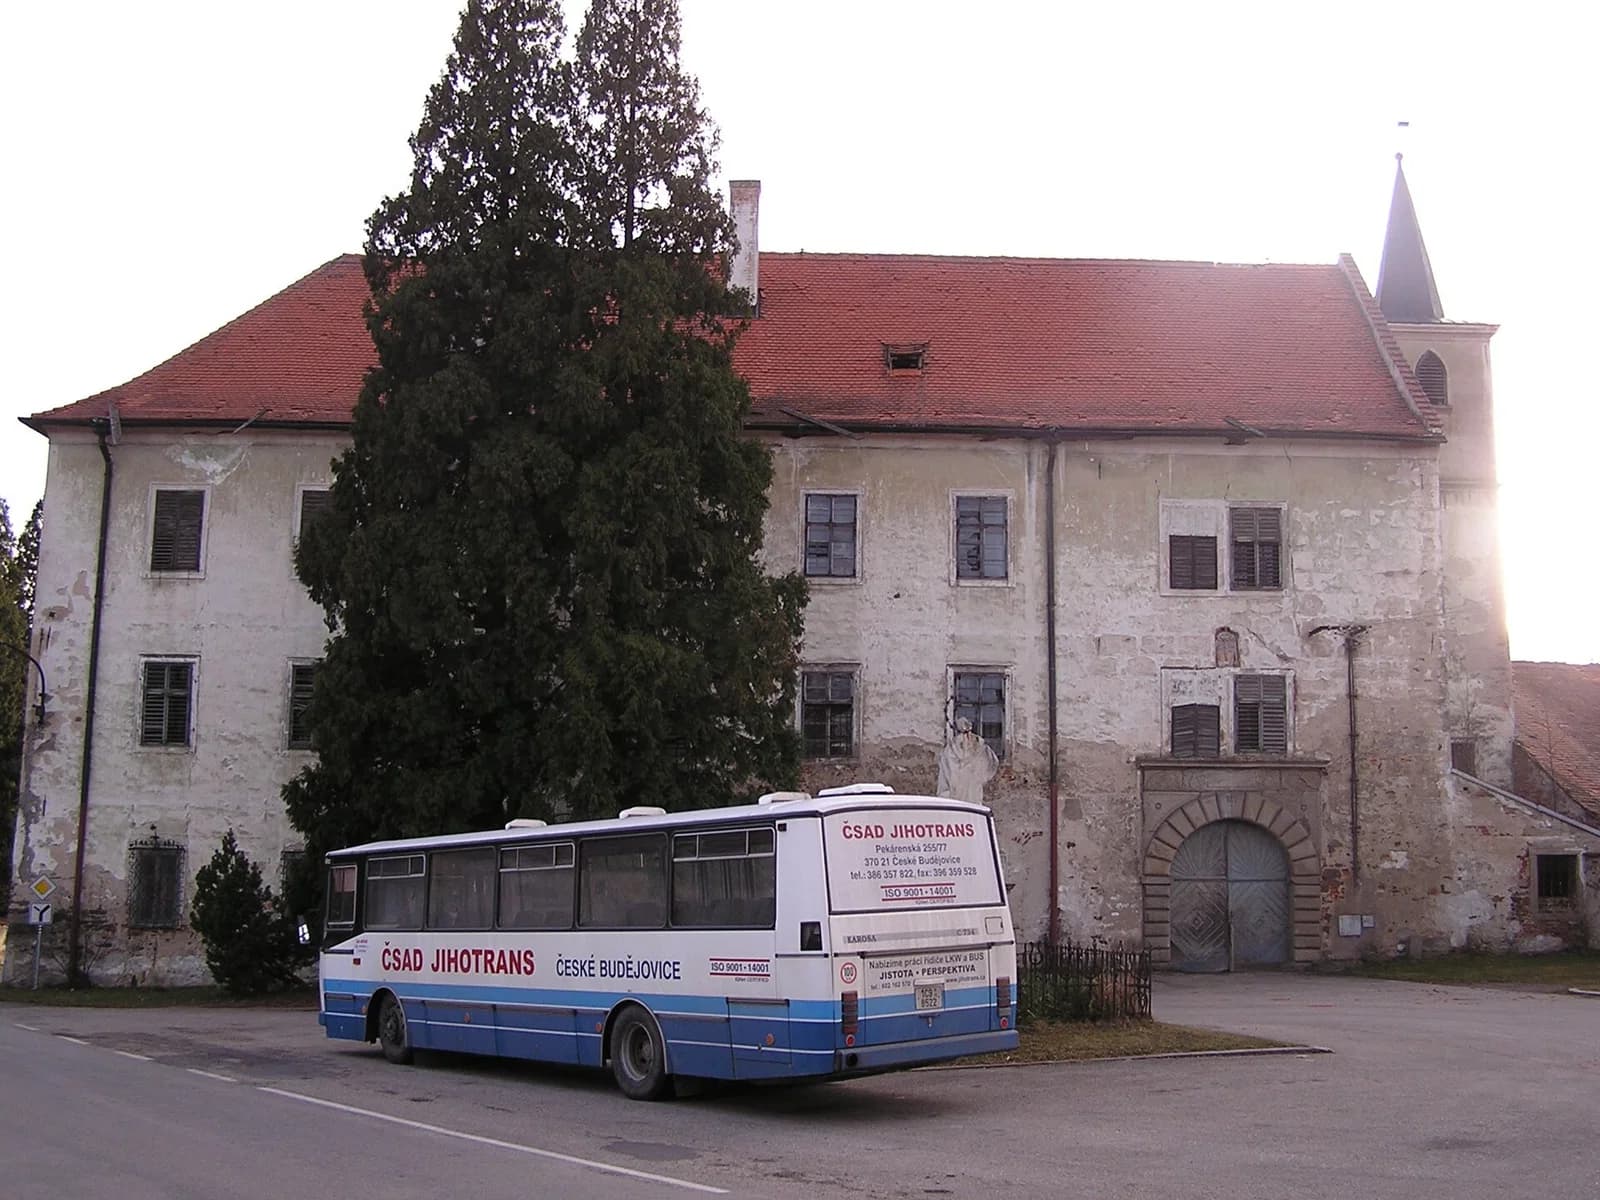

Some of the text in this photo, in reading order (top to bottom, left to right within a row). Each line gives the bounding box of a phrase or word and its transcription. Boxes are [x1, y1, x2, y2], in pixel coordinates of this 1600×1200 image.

[842, 821, 975, 839] ČSAD JIHOTRANS
[875, 843, 922, 854] Pekárenská
[864, 854, 961, 867] 370 21 České Budějovice
[883, 870, 897, 879] 357
[917, 867, 932, 877] fax:
[884, 888, 900, 897] ISO
[847, 934, 877, 944] KAROSA
[382, 941, 423, 972] ČSAD
[431, 948, 535, 976] JIHOTRANS
[945, 954, 961, 963] LKW
[969, 952, 985, 962] BUS
[556, 953, 681, 980] ČESKÉ BUDĚJOVICE
[711, 962, 725, 971] ISO
[880, 964, 976, 980] JISTOTA PERSPEKTIVA
